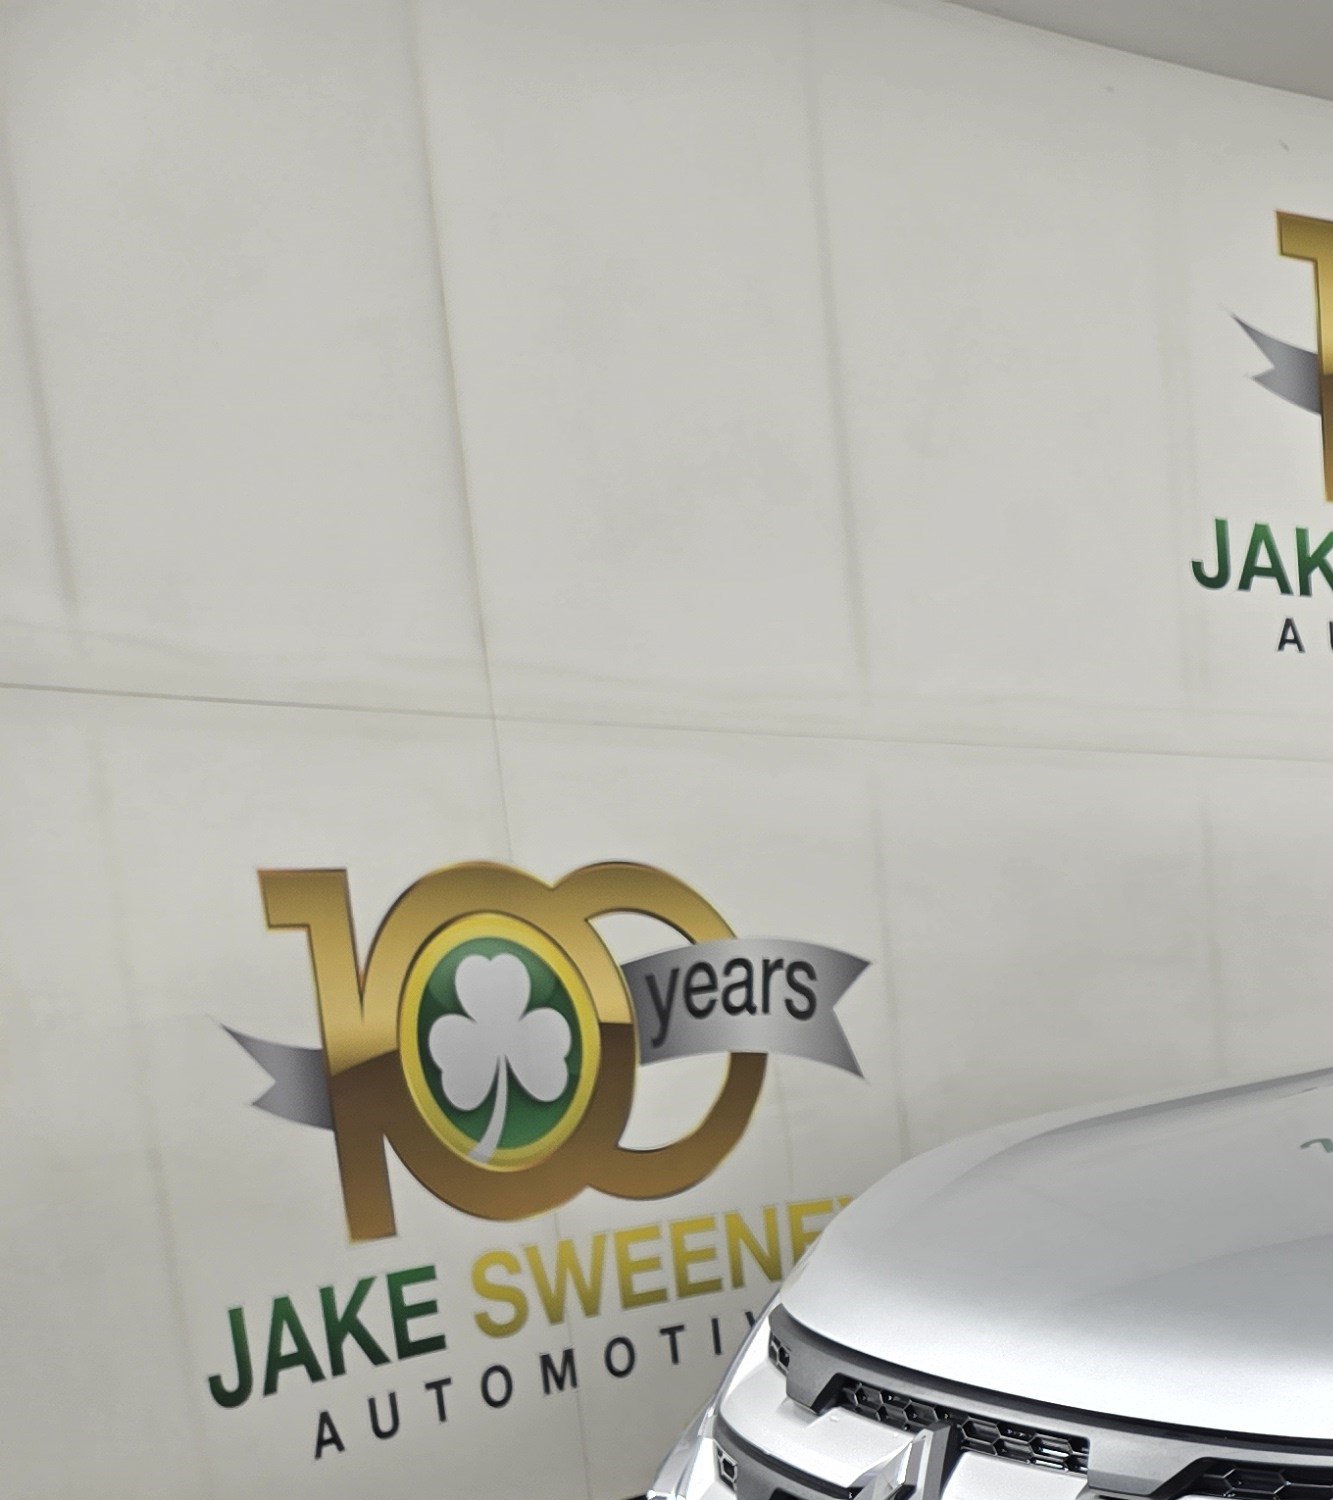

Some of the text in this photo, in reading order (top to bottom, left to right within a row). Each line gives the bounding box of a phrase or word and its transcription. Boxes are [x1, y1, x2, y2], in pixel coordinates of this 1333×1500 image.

[256, 861, 768, 1244] 100
[645, 956, 818, 1048] years
[207, 1195, 853, 1409] JAKE SWEENE
[313, 1311, 757, 1459] AUTOMOTI
